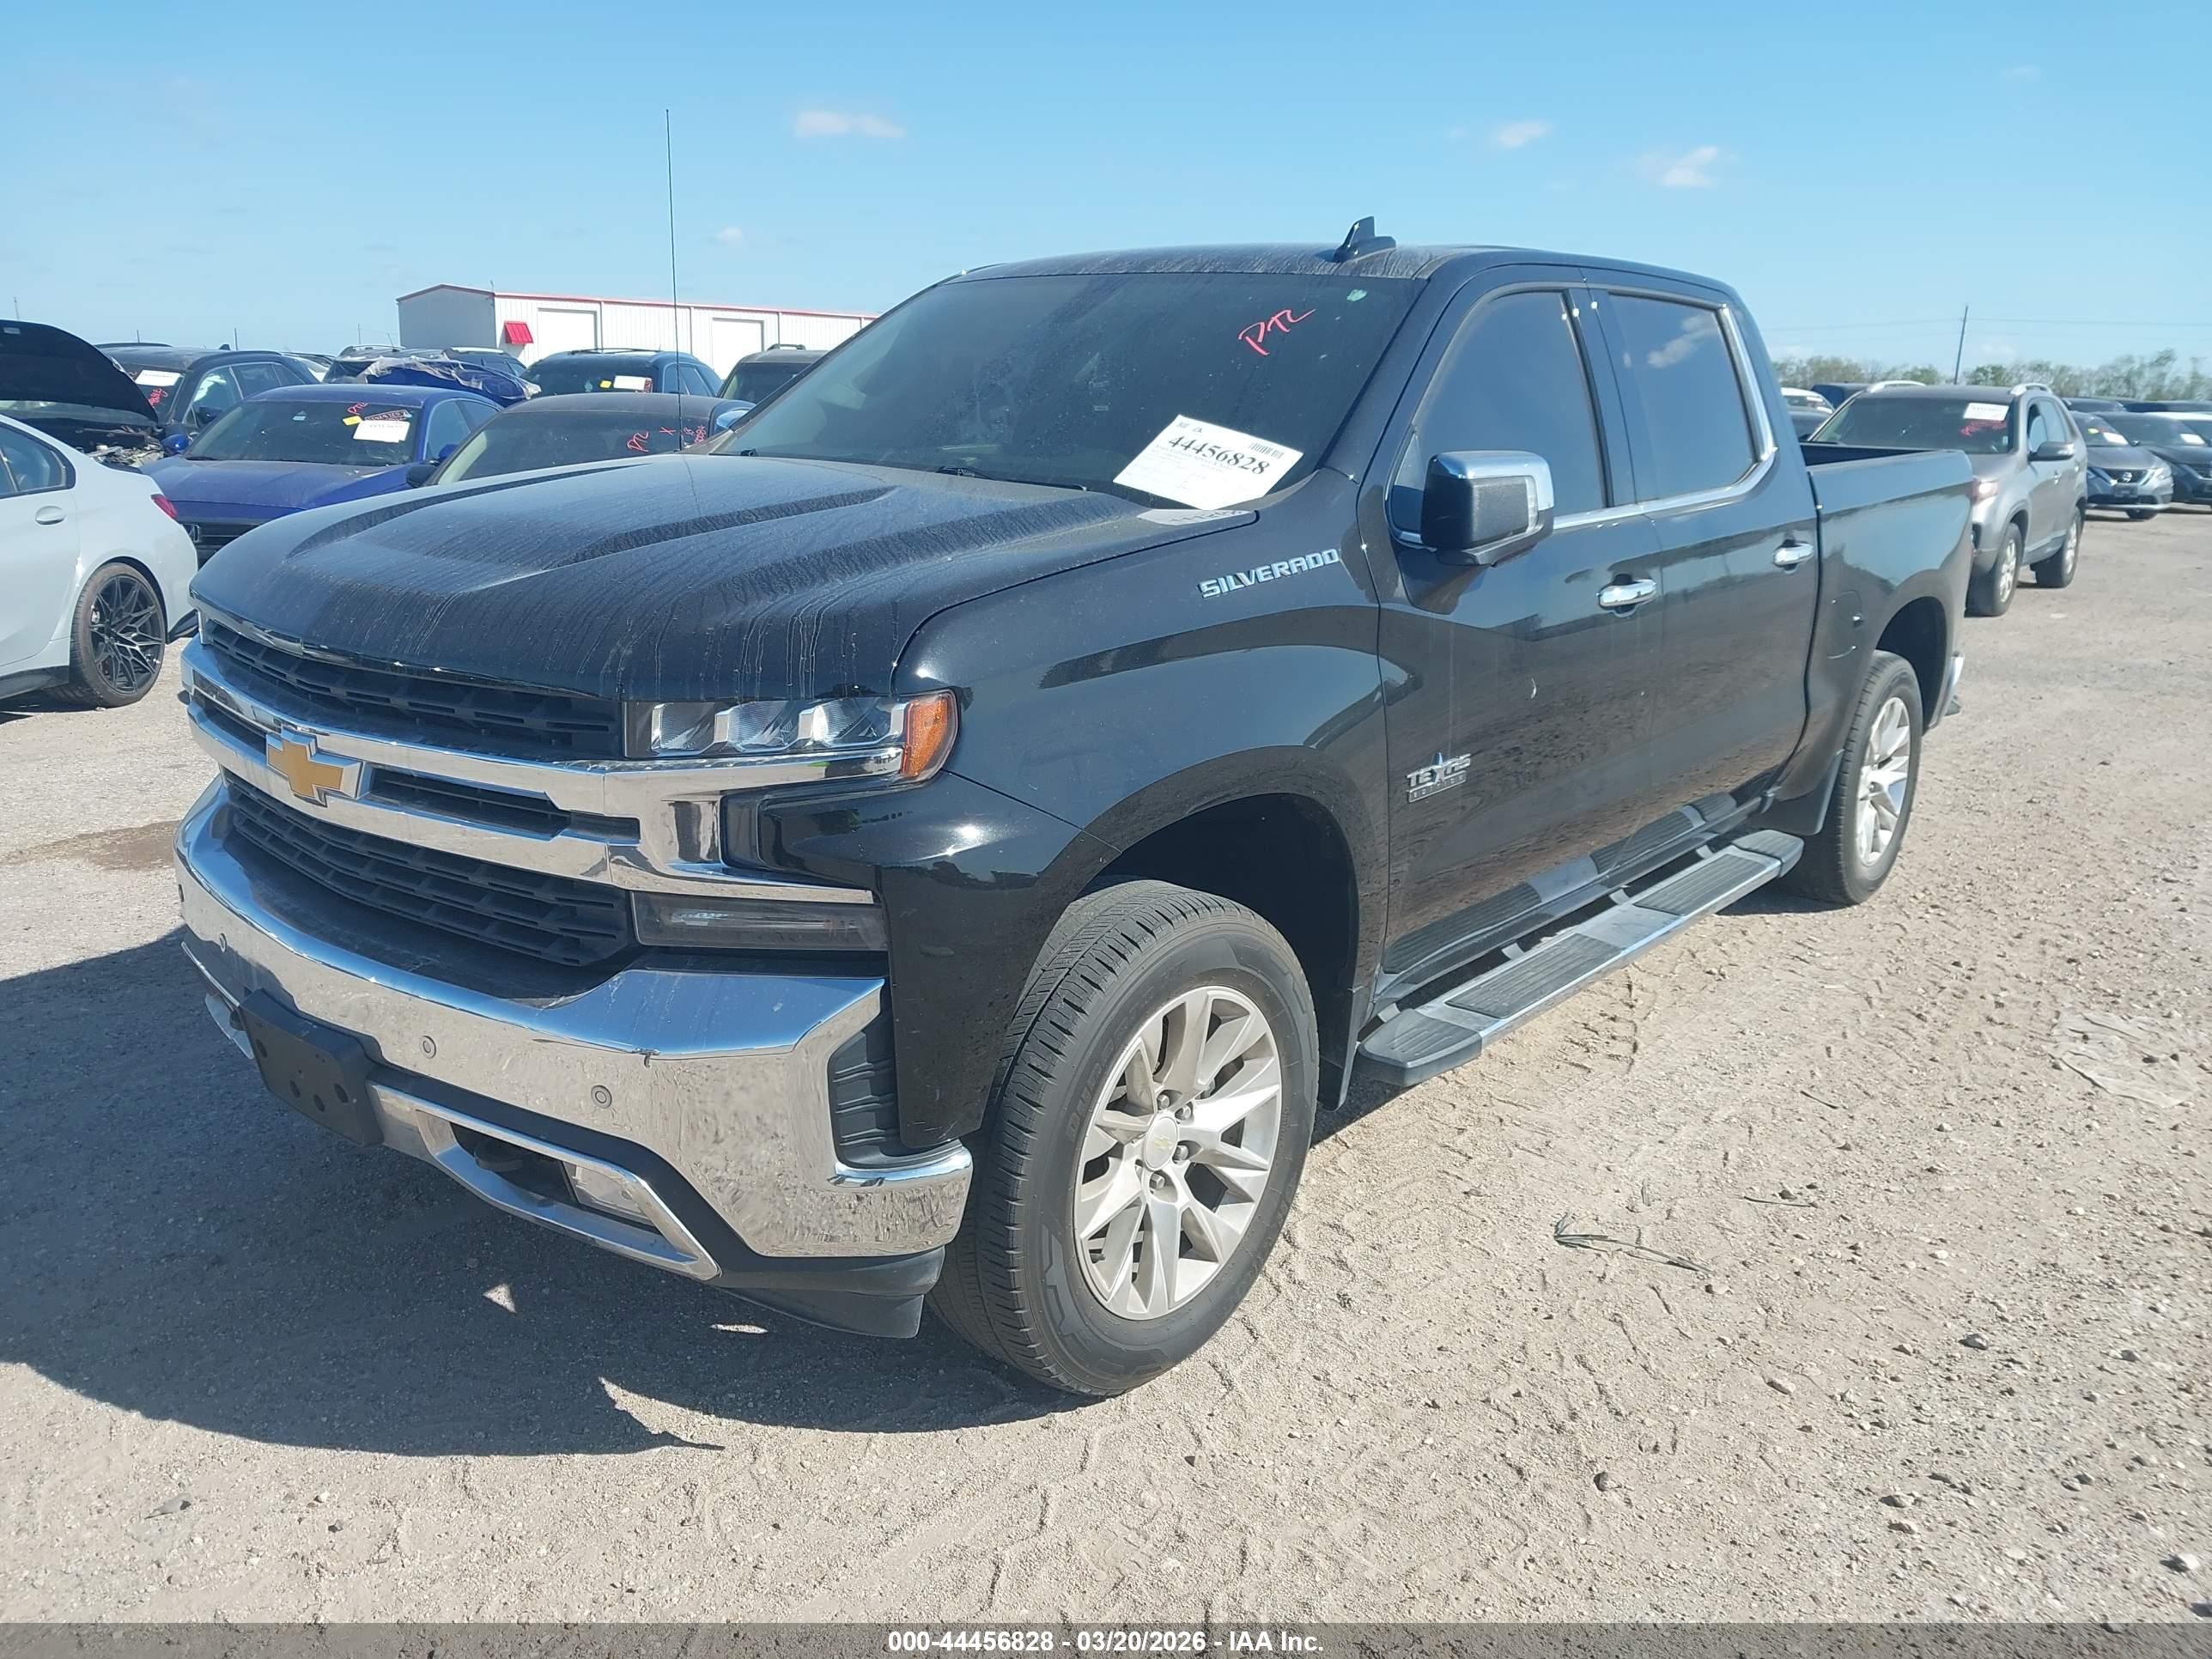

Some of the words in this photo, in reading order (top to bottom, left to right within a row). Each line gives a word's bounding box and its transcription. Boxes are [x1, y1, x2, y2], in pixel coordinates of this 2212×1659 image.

[1168, 435, 1271, 475] 44456828
[1199, 548, 1340, 599] SILVERADO
[1406, 752, 1471, 787] TEXAS
